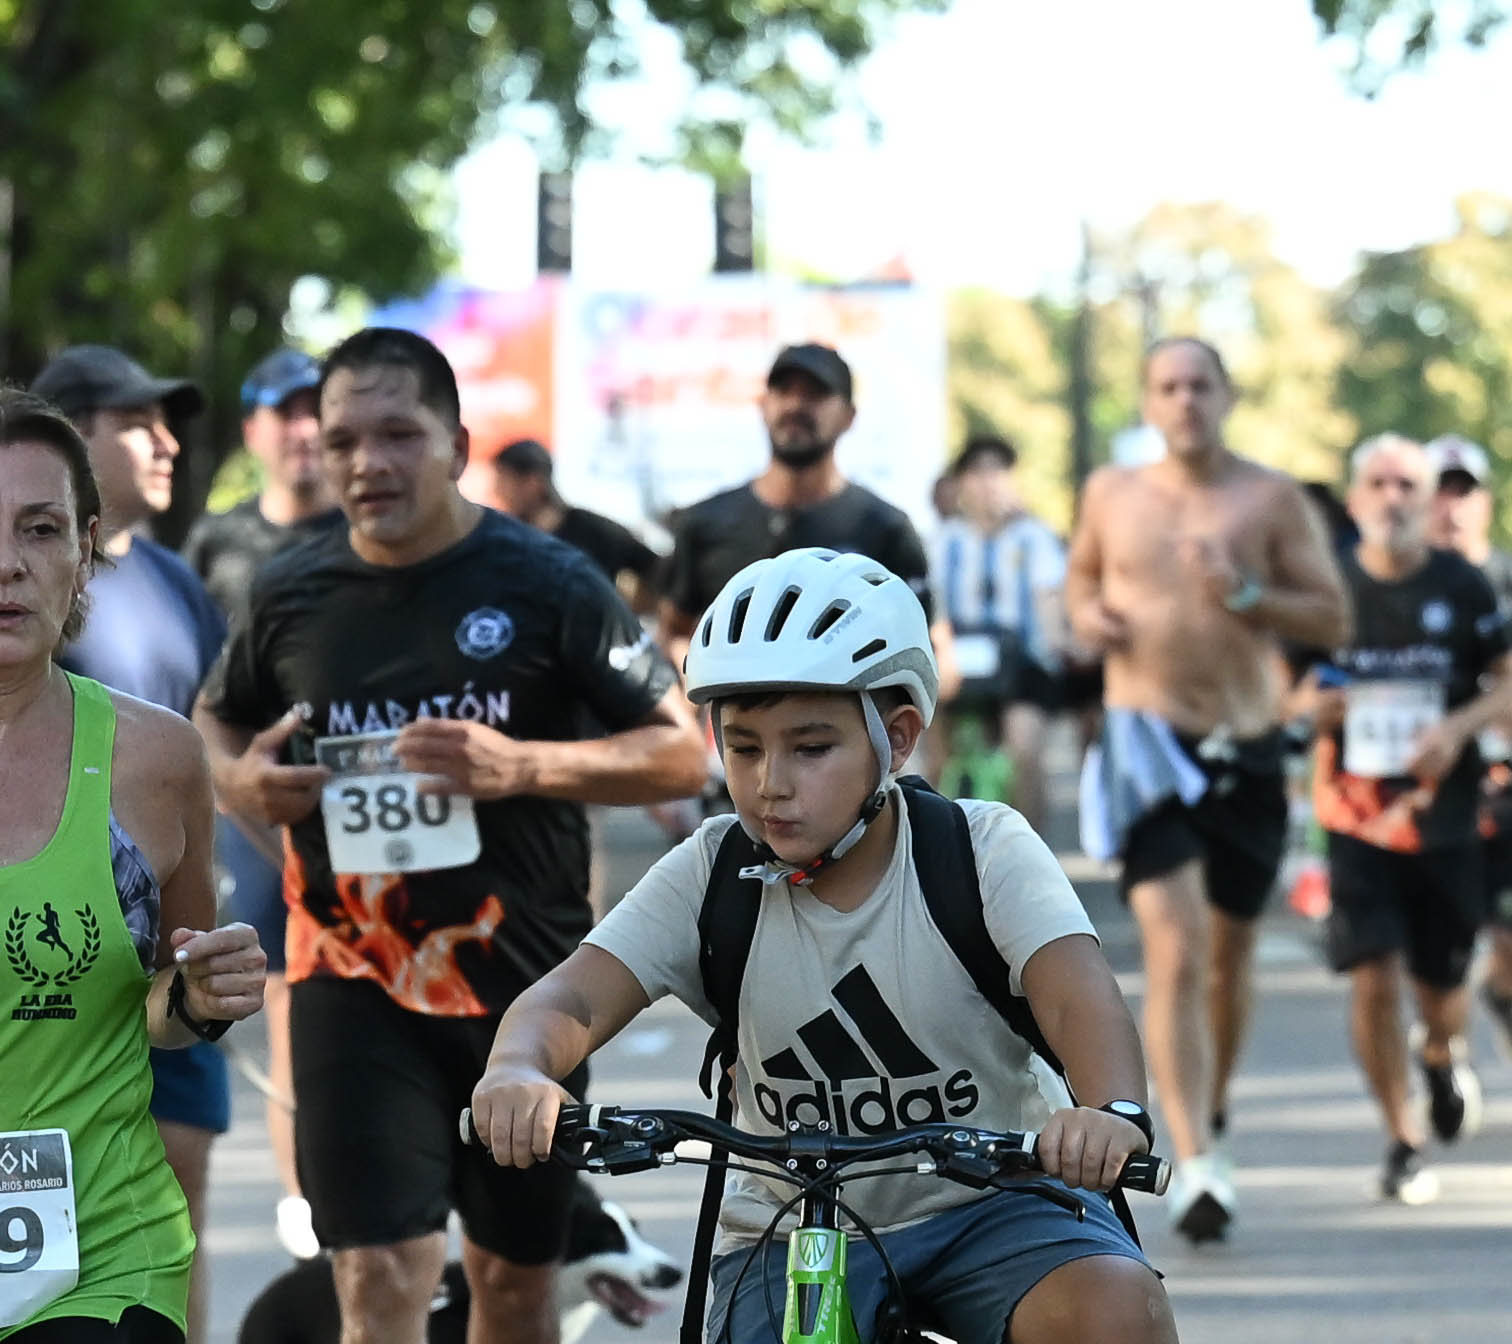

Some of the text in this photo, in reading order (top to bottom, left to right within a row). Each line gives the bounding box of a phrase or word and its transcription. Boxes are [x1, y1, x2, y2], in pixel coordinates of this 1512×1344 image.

[340, 784, 450, 834] 380
[754, 1069, 979, 1137] adidas
[24, 1177, 64, 1190] ROSARIO
